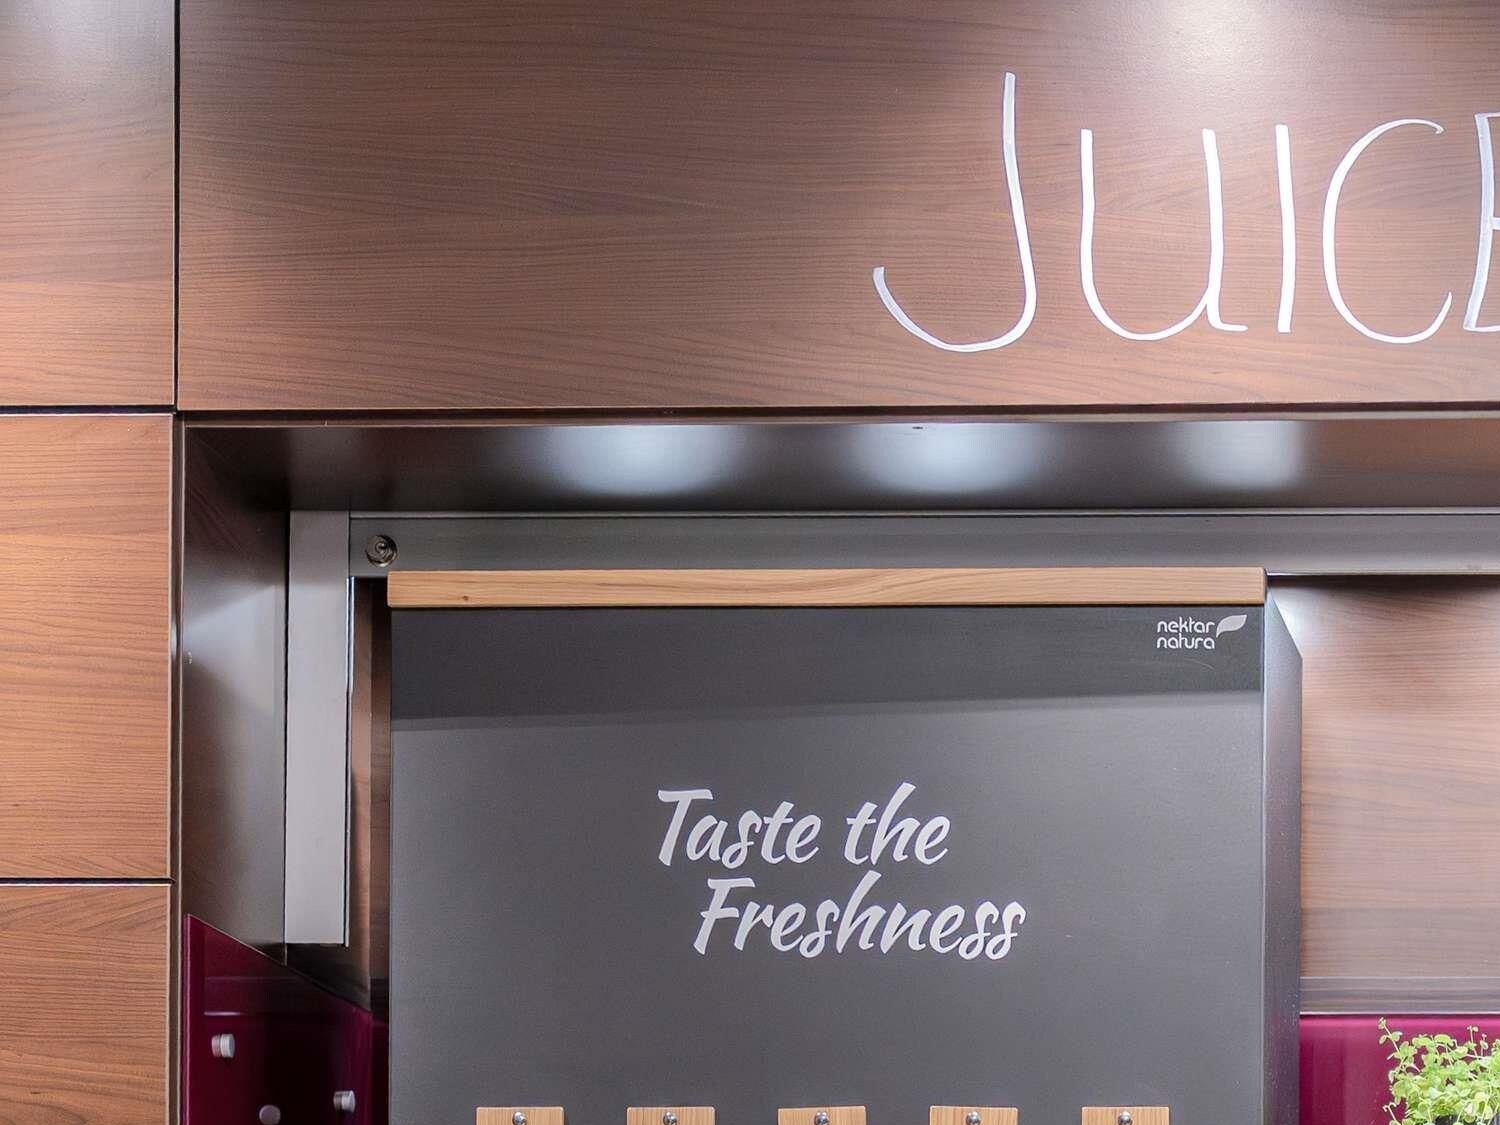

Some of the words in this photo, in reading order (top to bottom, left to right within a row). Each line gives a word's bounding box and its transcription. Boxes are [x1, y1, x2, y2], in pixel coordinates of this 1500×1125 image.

[1156, 633, 1215, 650] natura
[1157, 616, 1215, 633] nektar
[656, 787, 821, 869] Taste
[843, 781, 951, 867] the
[693, 871, 1027, 961] Freshness
